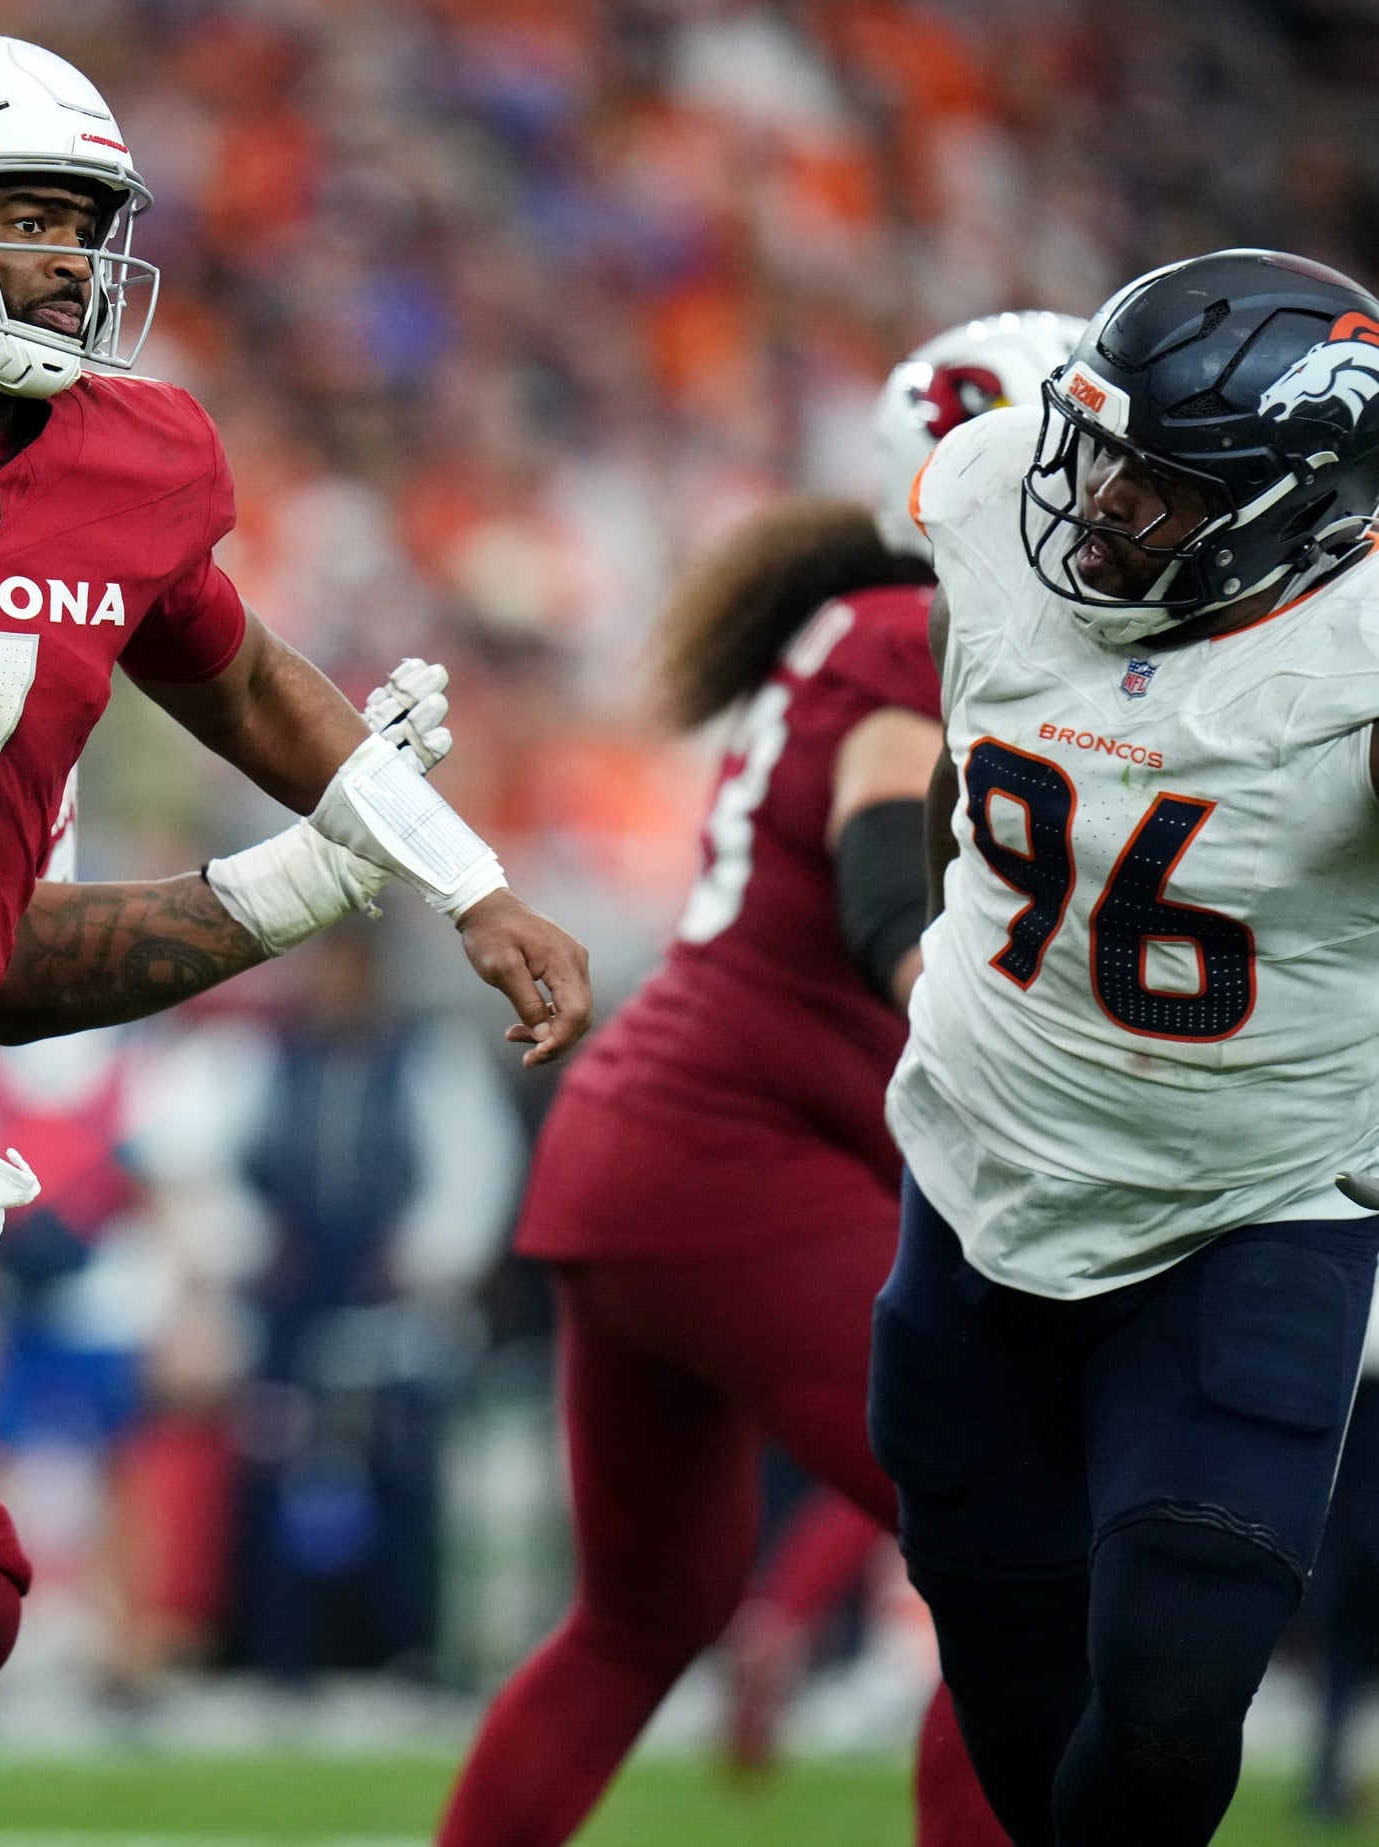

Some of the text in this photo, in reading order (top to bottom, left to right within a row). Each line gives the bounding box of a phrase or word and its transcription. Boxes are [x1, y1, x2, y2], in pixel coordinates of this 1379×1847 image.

[1124, 672, 1147, 692] NFL
[1039, 722, 1163, 769] BRONCOS
[964, 735, 1256, 1042] 96
